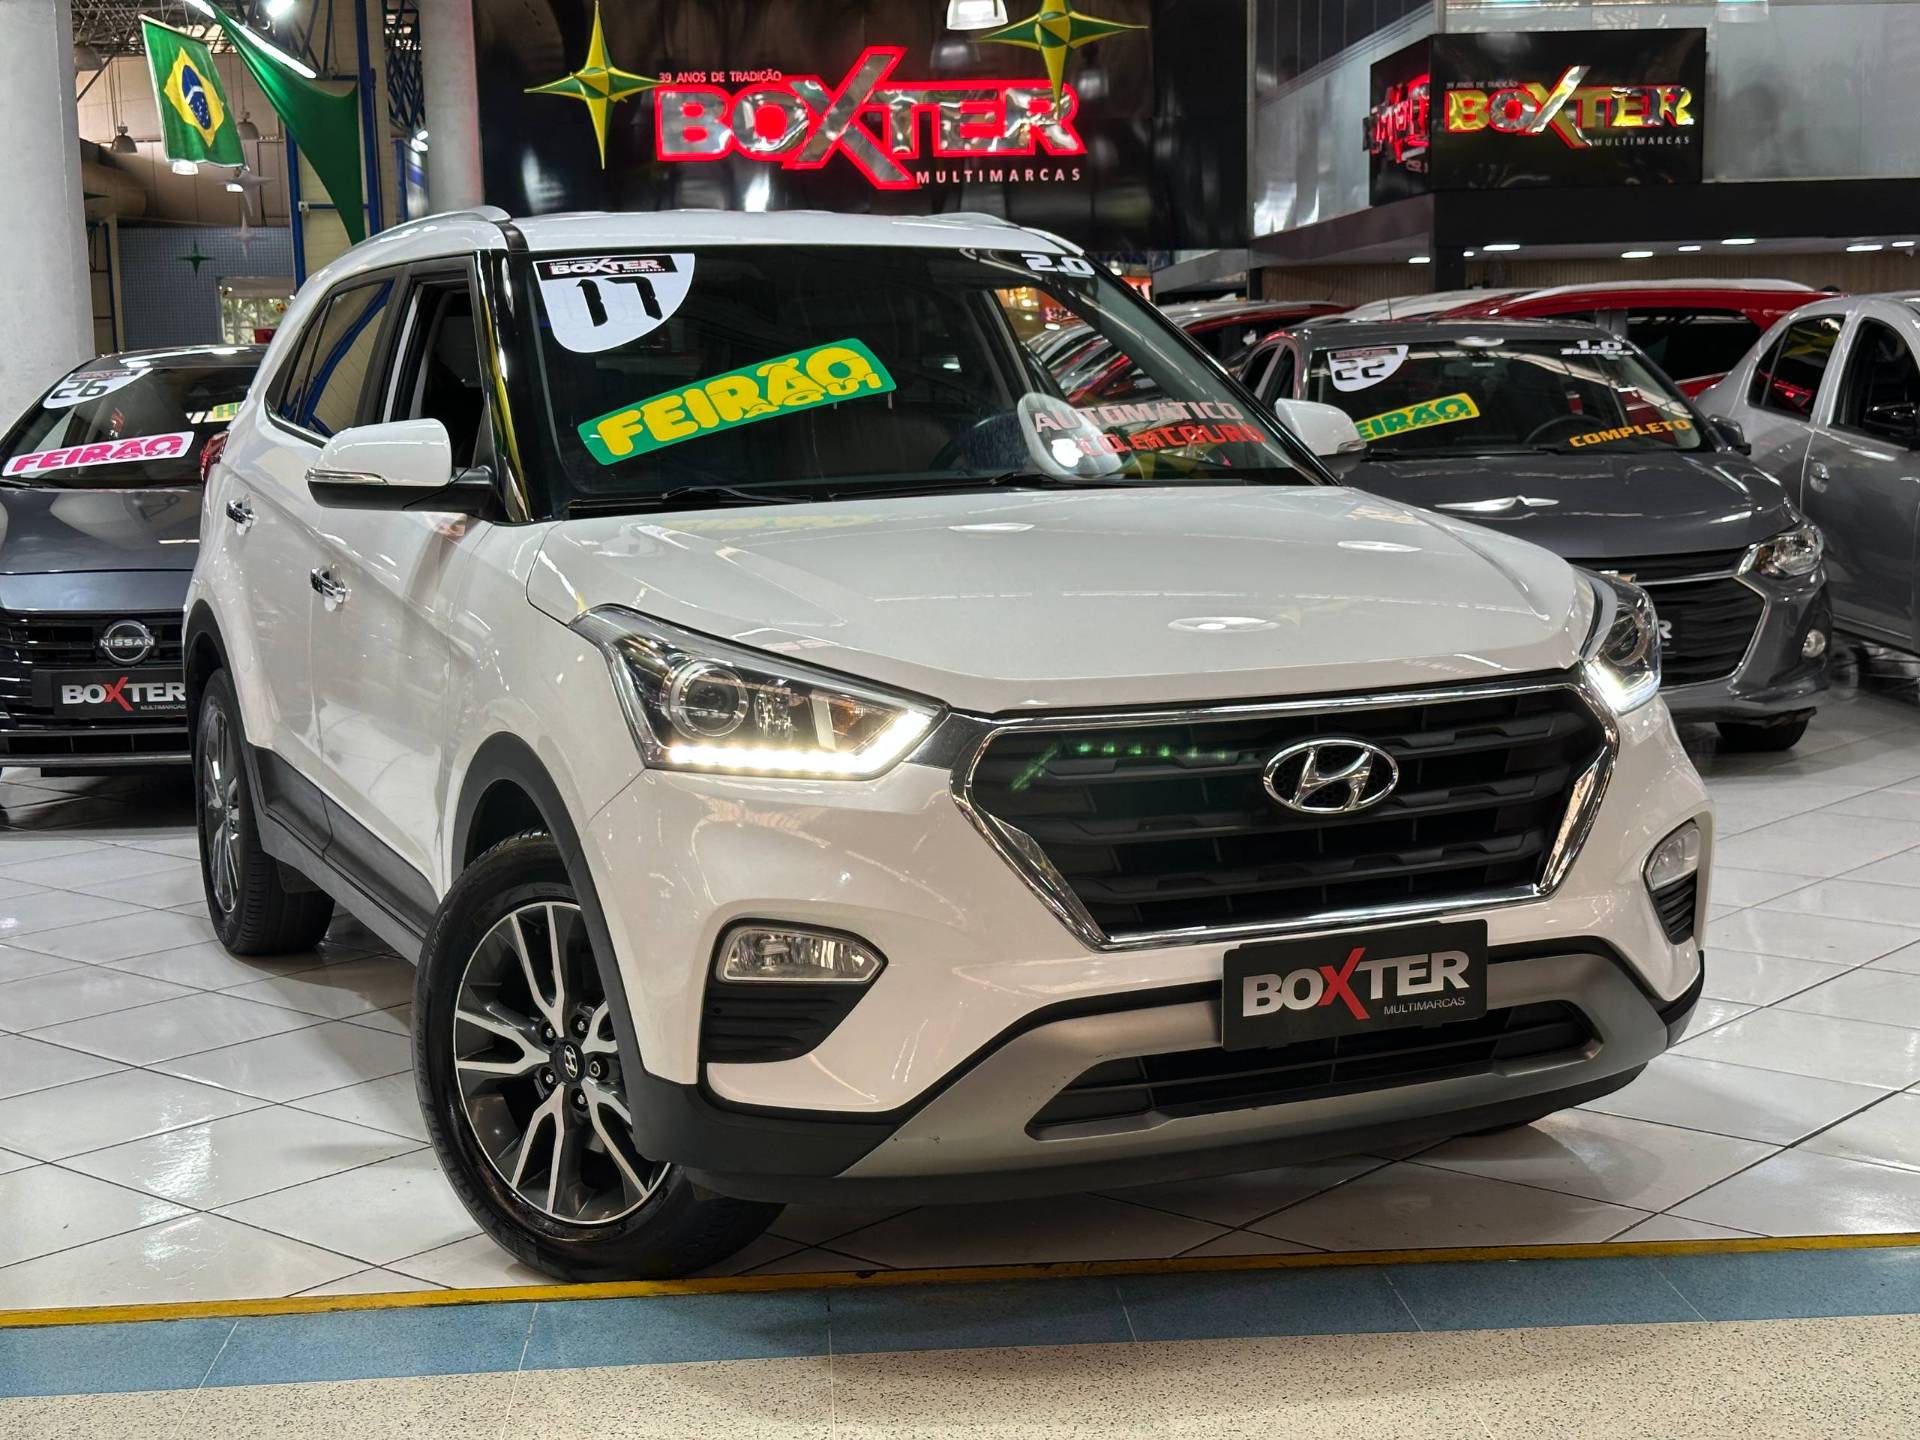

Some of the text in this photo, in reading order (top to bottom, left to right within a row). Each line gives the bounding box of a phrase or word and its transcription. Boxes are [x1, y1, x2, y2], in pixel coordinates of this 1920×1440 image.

[659, 69, 782, 83] 39 ANOS DE TRADIÇÃO
[656, 45, 1087, 190] BOXTER
[1444, 65, 1695, 149] BOXTER
[1594, 135, 1690, 147] MULTIMARCAS
[916, 168, 1081, 184] MULTIMARCAS
[549, 258, 662, 276] BOXTER
[1020, 253, 1096, 276] 2.0
[576, 275, 663, 327] 17
[1576, 340, 1622, 350] 1.0
[1334, 359, 1385, 381] 22
[50, 379, 108, 399] 26
[597, 346, 874, 456] FEIRÃO
[1356, 398, 1470, 439] EIRÃO
[1161, 421, 1265, 447] COURO
[1568, 420, 1692, 447] COMPLETO
[12, 436, 183, 472] FEIRÃO
[100, 637, 154, 647] NISSAN
[61, 676, 186, 712] BOXTER
[1242, 946, 1470, 1020] BOXTER
[1383, 996, 1466, 1016] MULTIMARCAS
